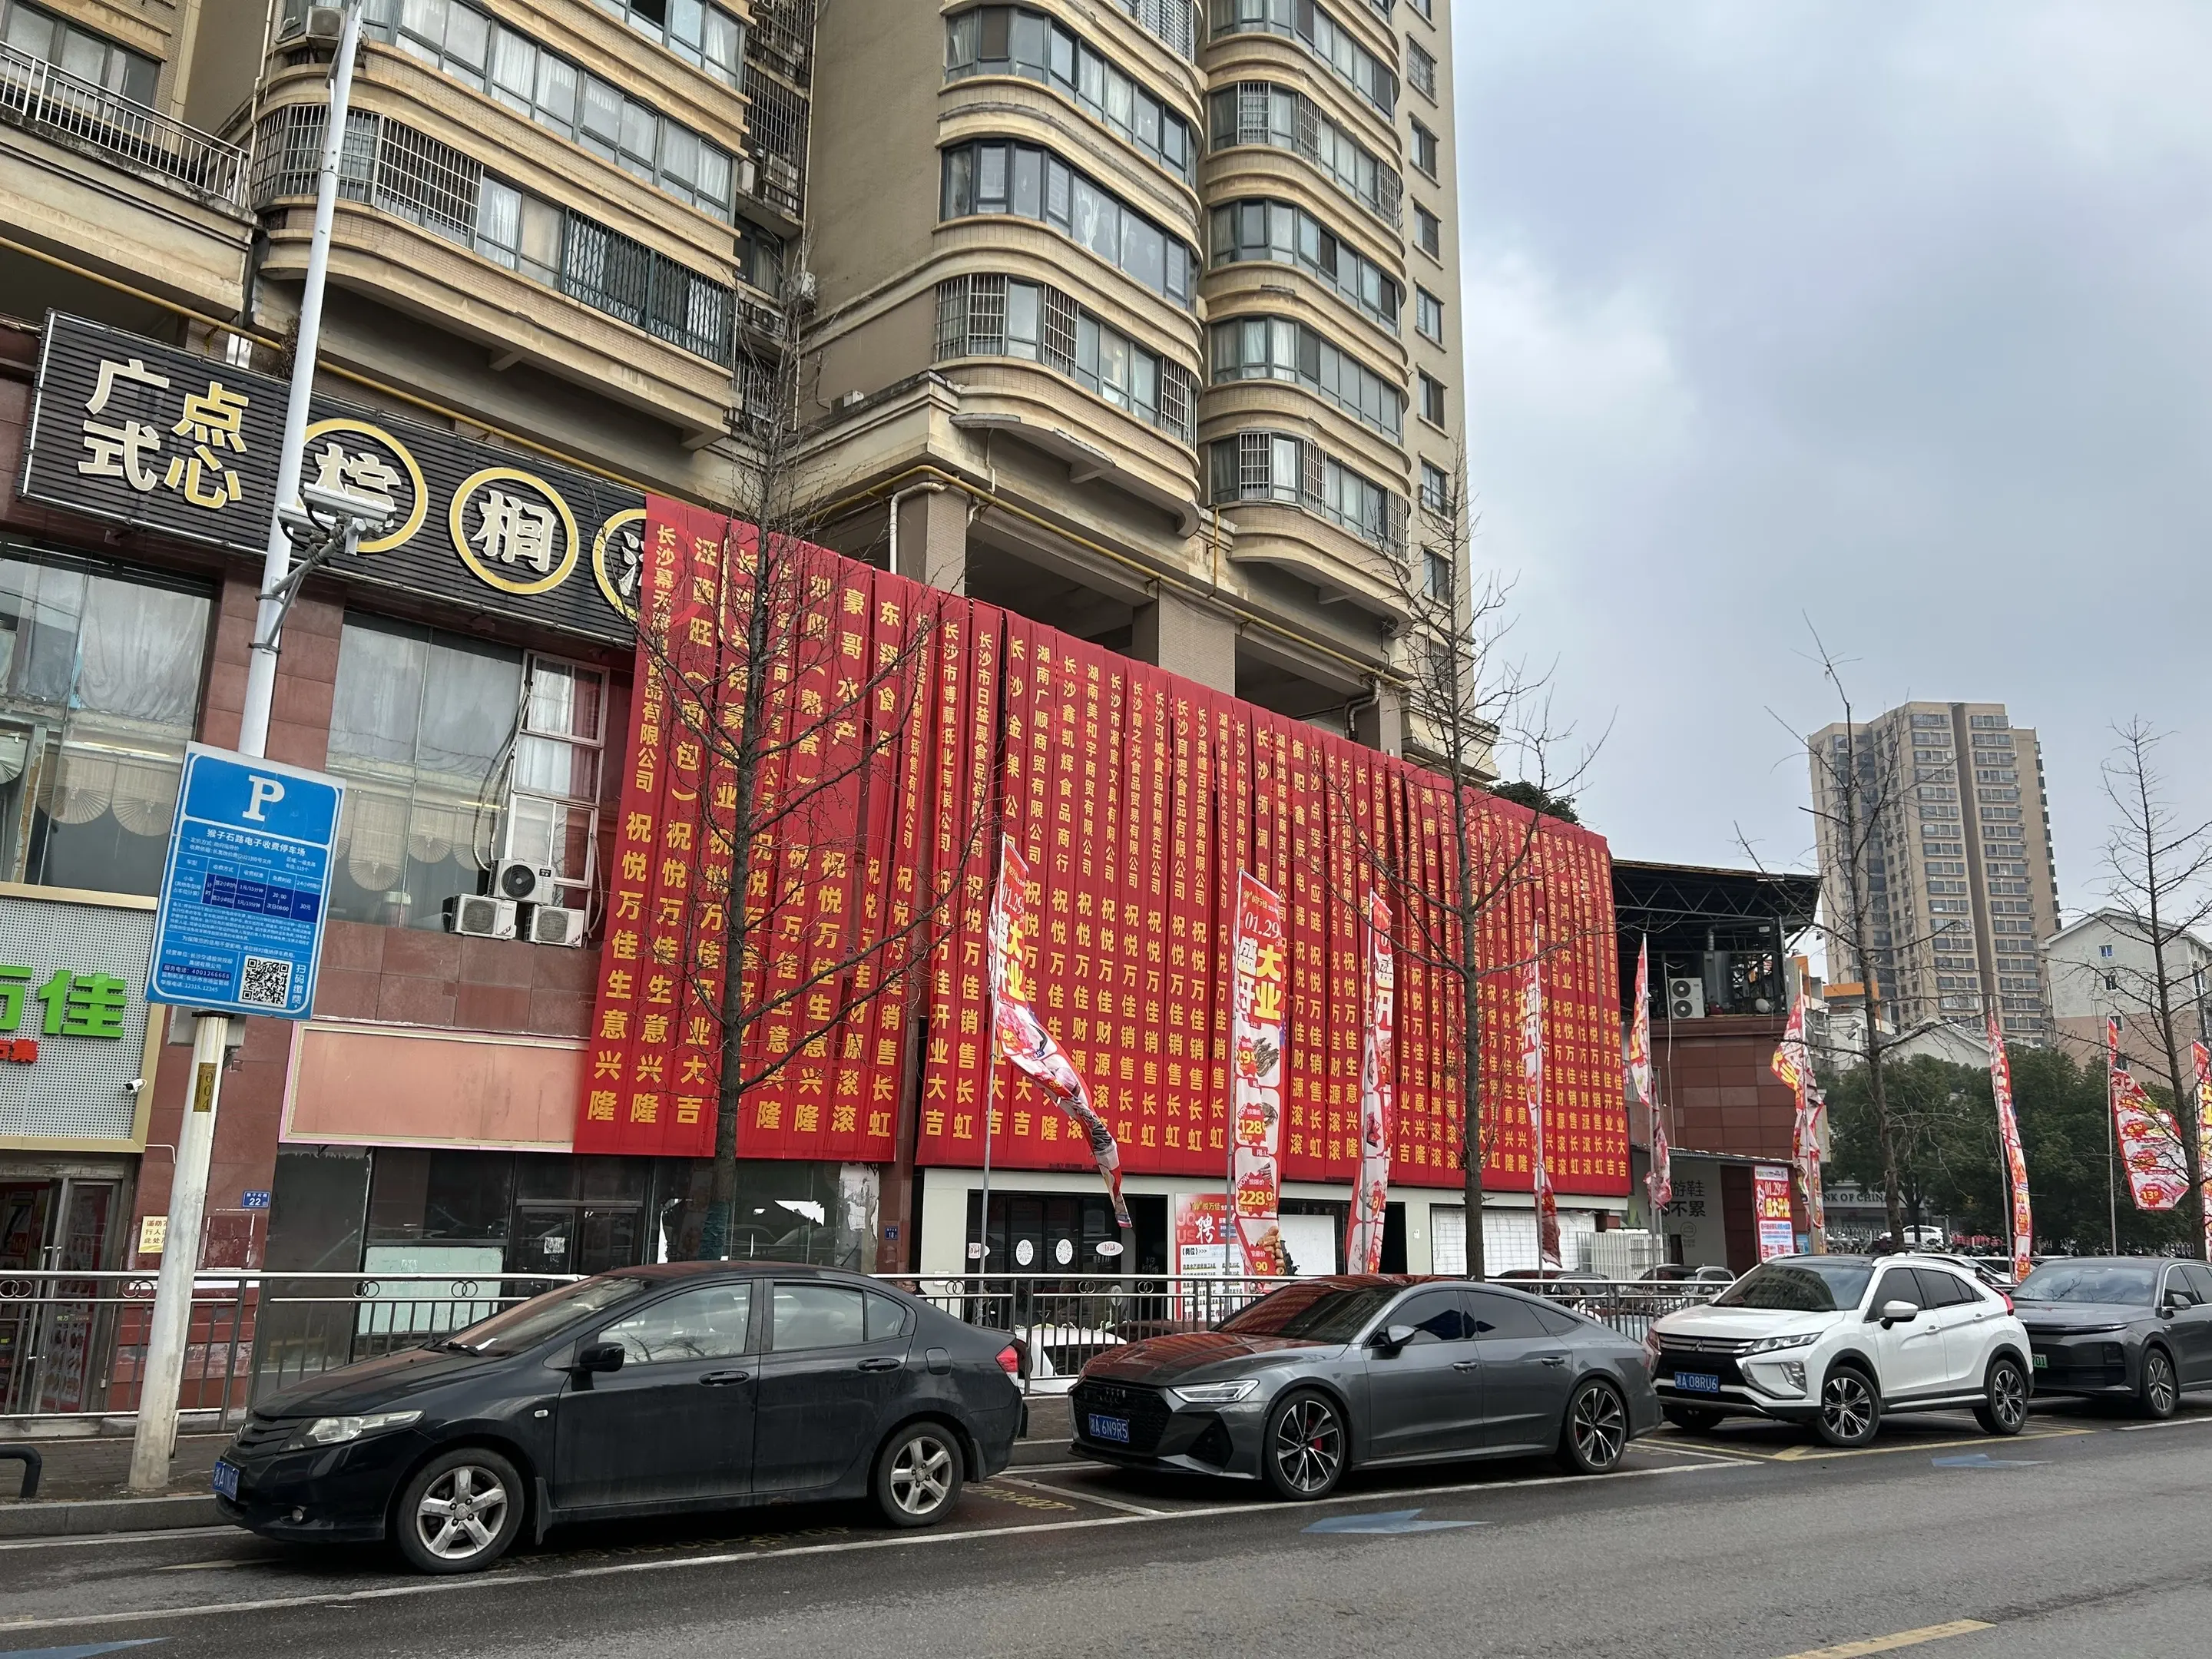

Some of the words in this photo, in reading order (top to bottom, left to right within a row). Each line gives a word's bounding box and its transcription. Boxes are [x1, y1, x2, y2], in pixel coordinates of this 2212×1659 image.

[78, 359, 170, 492] 广式
[164, 382, 250, 510] 点心
[313, 442, 645, 597] 棕榈
[832, 588, 866, 744] 豪哥水产
[1028, 645, 1051, 864] 湖南广顺商贸有限公司
[1056, 657, 1076, 869] 长沙鑫凯辉食品商行
[207, 828, 307, 857] 猴子石路电子收费停车场
[241, 774, 286, 823] P
[1128, 682, 1143, 888] 长沙霞之光食品贸易有限公司
[1151, 693, 1165, 895] 长沙可城食品有限责任公司
[1292, 740, 1306, 926] 衡阳鑫辰电器
[588, 811, 652, 1121] 祝悦万佳生意兴隆
[630, 821, 692, 1124] 祝悦万佳生意兴隆
[677, 828, 733, 1124] 祝悦万佳开业大吉
[756, 844, 810, 1129] 祝悦万佳生意兴隆
[794, 849, 846, 1132] 祝悦万佳生意兴隆
[868, 866, 912, 1137] 祝悦万佳销售长虹
[926, 870, 952, 1136] 祝悦万佳开业大吉
[953, 874, 984, 1139] 祝悦万佳销售长虹
[1012, 881, 1042, 1137] 祝悦万佳大吉
[1041, 889, 1068, 1141] 祝悦万佳生隆
[1067, 892, 1092, 1139] 祝悦万佳财源滚
[1117, 904, 1139, 1144] 祝悦万佳销售长虹
[1141, 910, 1162, 1147] 祝悦万佳销售长虹
[1164, 915, 1186, 1147] 祝悦万佳销售长虹
[1187, 921, 1207, 1151] 祝悦万佳销售长虹
[1210, 926, 1229, 1149] 祝悦万佳销售长虹
[1290, 939, 1308, 1155] 祝悦万佳财源滚滚
[1309, 945, 1323, 1158] 祝悦万佳销售长虹
[1327, 951, 1343, 1161] 祝悦万佳财源滚滚
[1343, 952, 1359, 1158] 祝悦万佳生意兴隆
[1411, 968, 1426, 1164] 祝悦万佳生意兴隆
[1502, 988, 1517, 1172] 祝悦万佳生意兴隆
[1562, 1001, 1579, 1174] 祝悦万佳销售长虹
[1588, 1005, 1602, 1174] 祝悦万佳销售长虹
[1610, 1011, 1628, 1177] 祝悦万佳开业大吉
[248, 1197, 262, 1207] 22
[1841, 1193, 1854, 1202] OF
